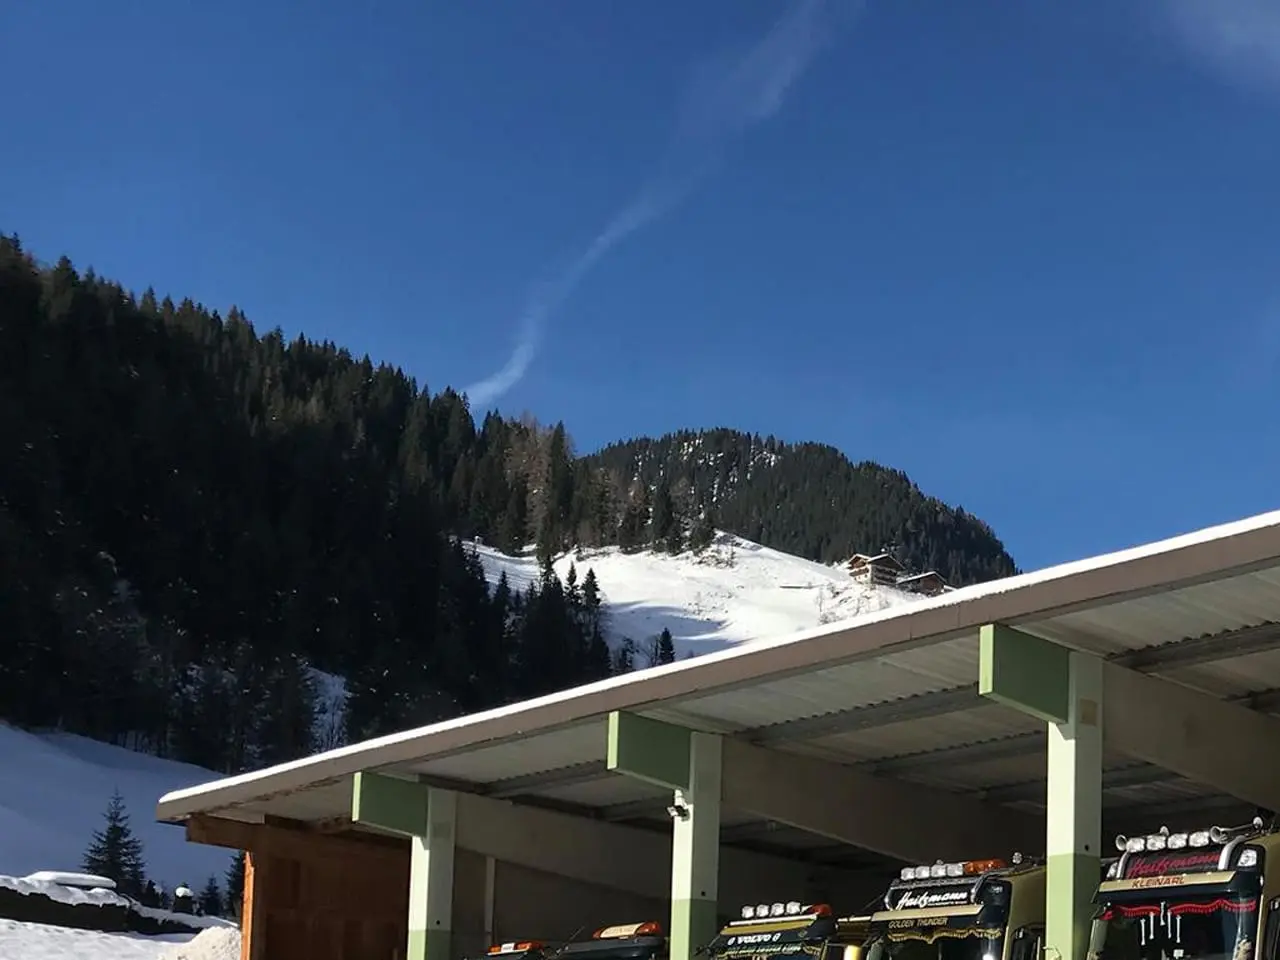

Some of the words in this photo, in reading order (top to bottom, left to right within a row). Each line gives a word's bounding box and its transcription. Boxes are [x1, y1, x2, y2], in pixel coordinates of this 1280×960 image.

[1132, 876, 1185, 888] KLEINARL
[895, 891, 968, 910] Haitzmann
[737, 934, 771, 944] VOLVO
